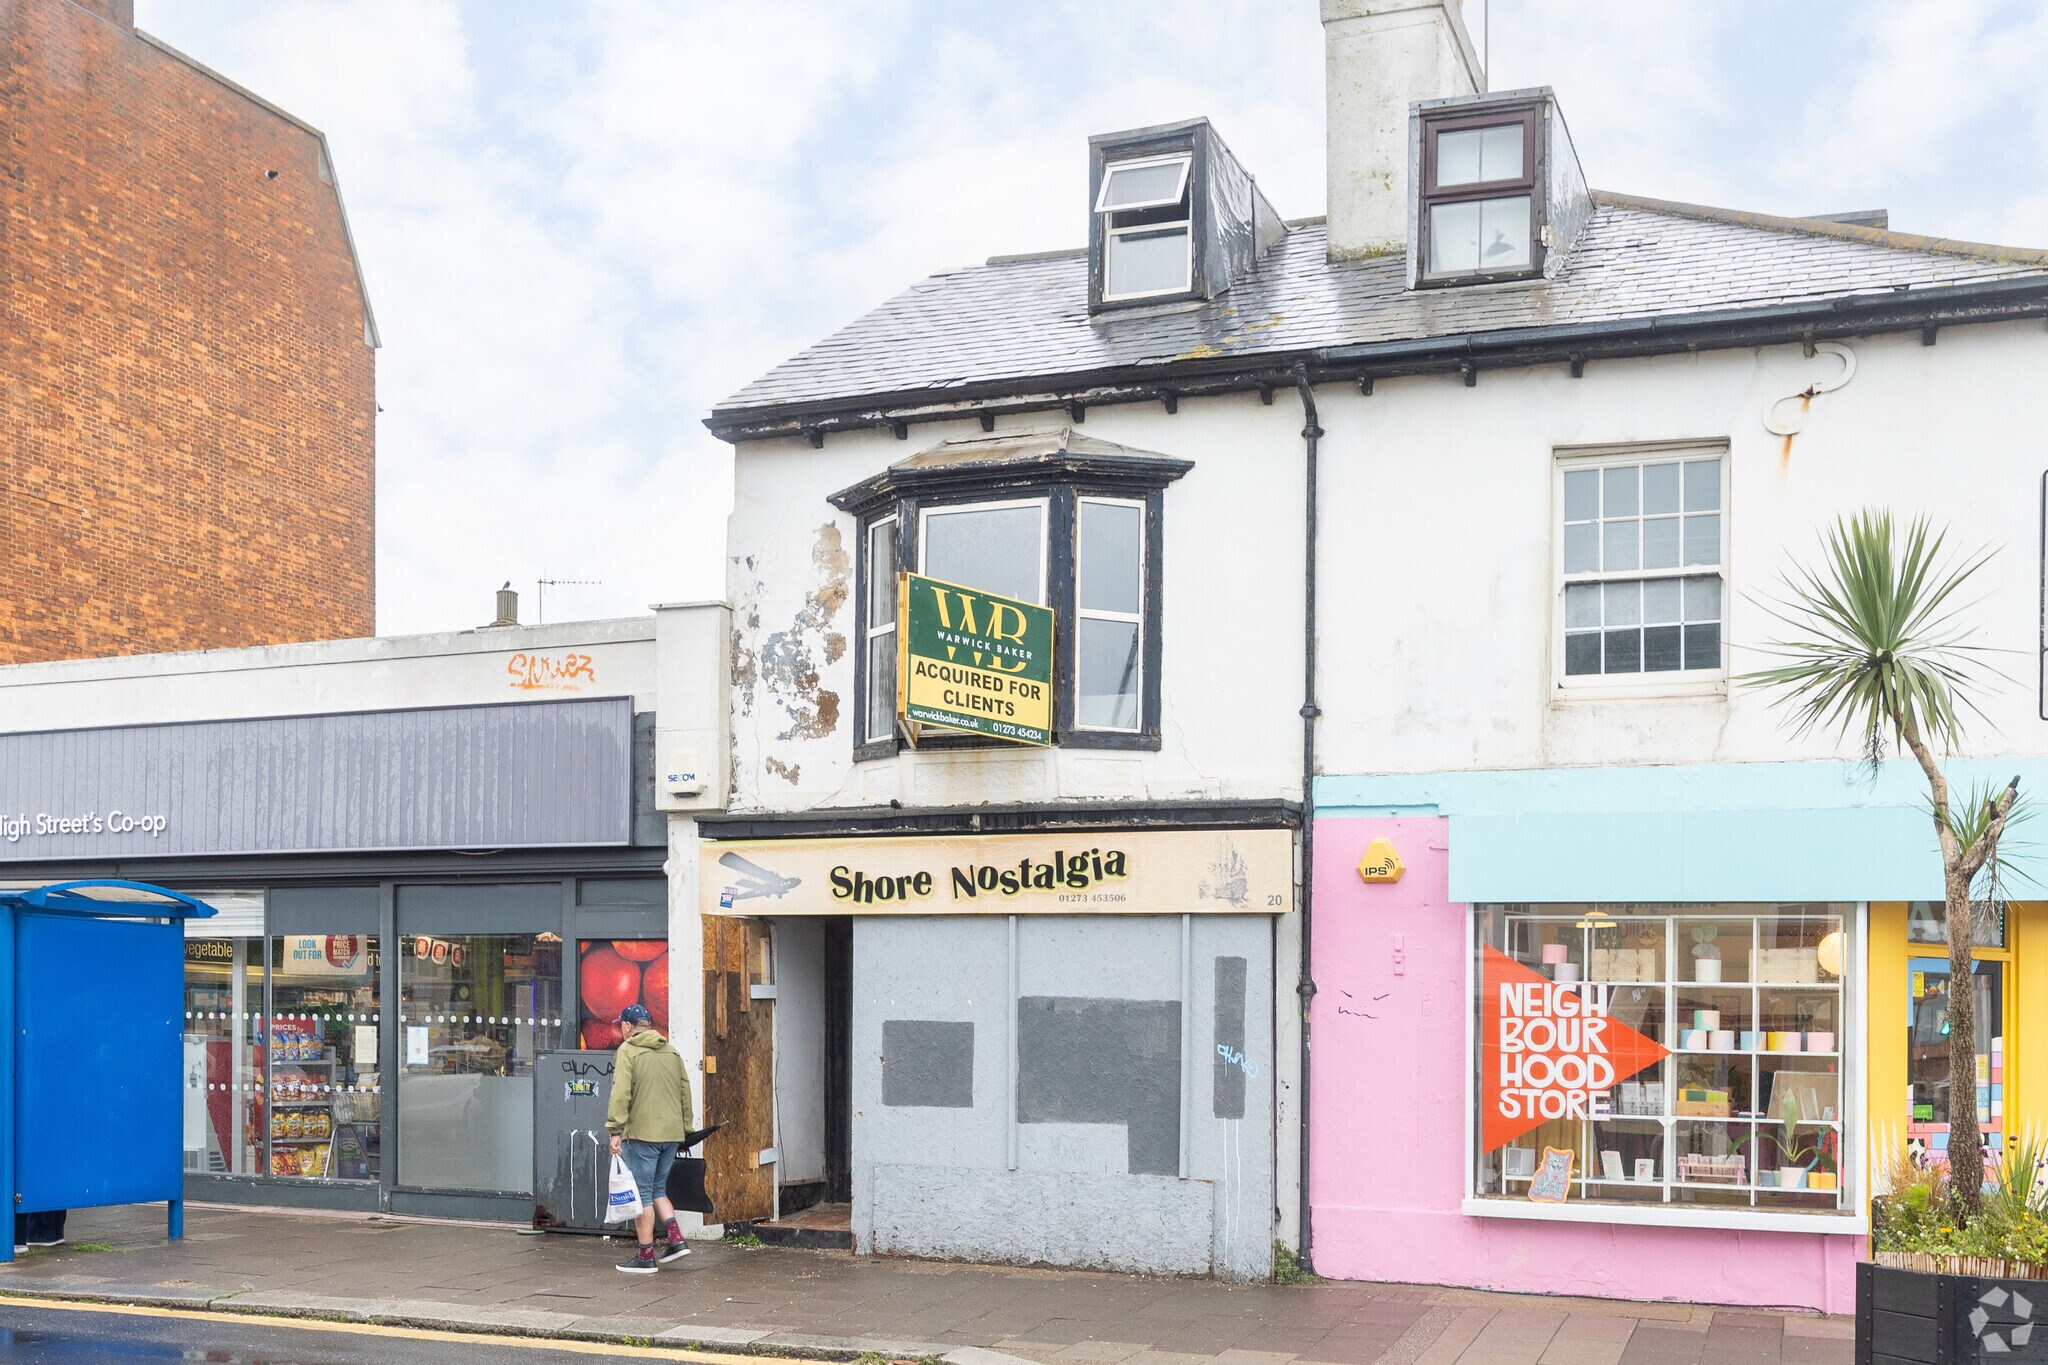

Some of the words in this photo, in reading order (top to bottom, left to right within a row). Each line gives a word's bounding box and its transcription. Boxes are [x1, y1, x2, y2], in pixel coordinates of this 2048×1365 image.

[937, 630, 991, 651] WARWICK
[997, 644, 1033, 660] BAKER
[915, 661, 1004, 692] ACQUIRED
[1009, 680, 1041, 701] FOR
[943, 689, 1015, 717] CLIENTS
[912, 708, 979, 729] warwickbaker.co.uk
[993, 722, 1016, 736] 01273
[1017, 725, 1042, 740] 454234
[668, 773, 696, 782] SECOM
[36, 811, 103, 836] Street's
[107, 809, 168, 838] Co-op
[830, 865, 932, 903] Shore
[951, 847, 1126, 899] Nostalgia
[1365, 866, 1387, 876] IPS
[1059, 894, 1088, 903] 01273
[1091, 893, 1126, 902] 453506
[1267, 894, 1282, 906] 20
[293, 950, 307, 960] OUT
[307, 950, 322, 960] FOR
[298, 939, 317, 949] LOOK
[332, 940, 350, 949] PRICE
[1500, 982, 1608, 1018] NEIGH
[1500, 1017, 1609, 1054] BOUR
[1500, 1053, 1615, 1090] HOOD
[1498, 1088, 1611, 1121] STORE
